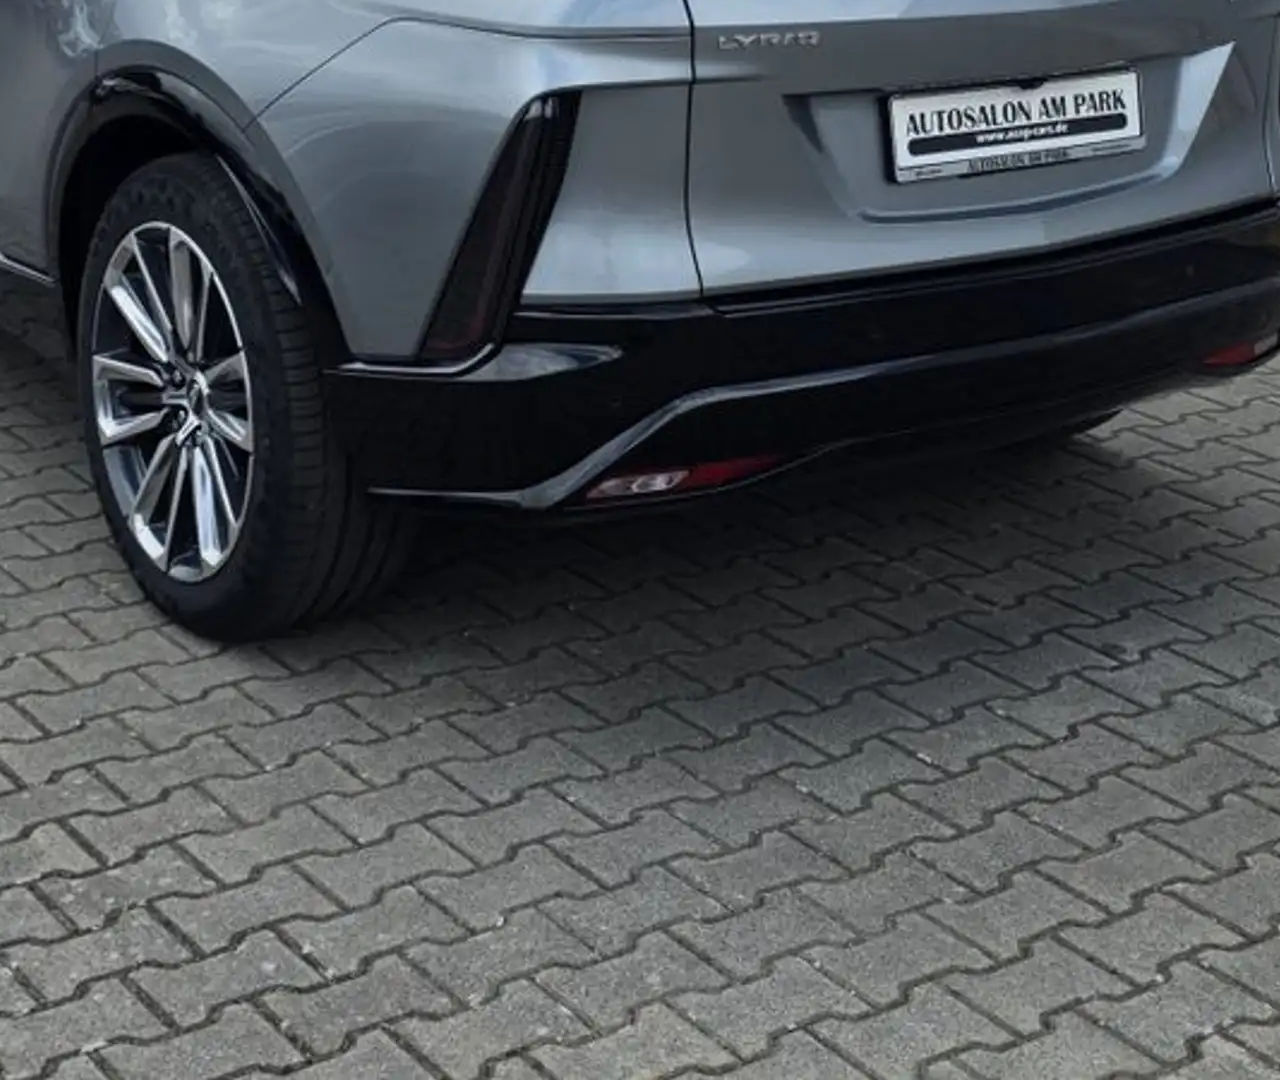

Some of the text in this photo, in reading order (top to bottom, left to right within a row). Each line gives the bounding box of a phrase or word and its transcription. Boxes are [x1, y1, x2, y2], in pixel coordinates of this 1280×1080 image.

[906, 88, 1127, 137] AUTOSALON AM PARK
